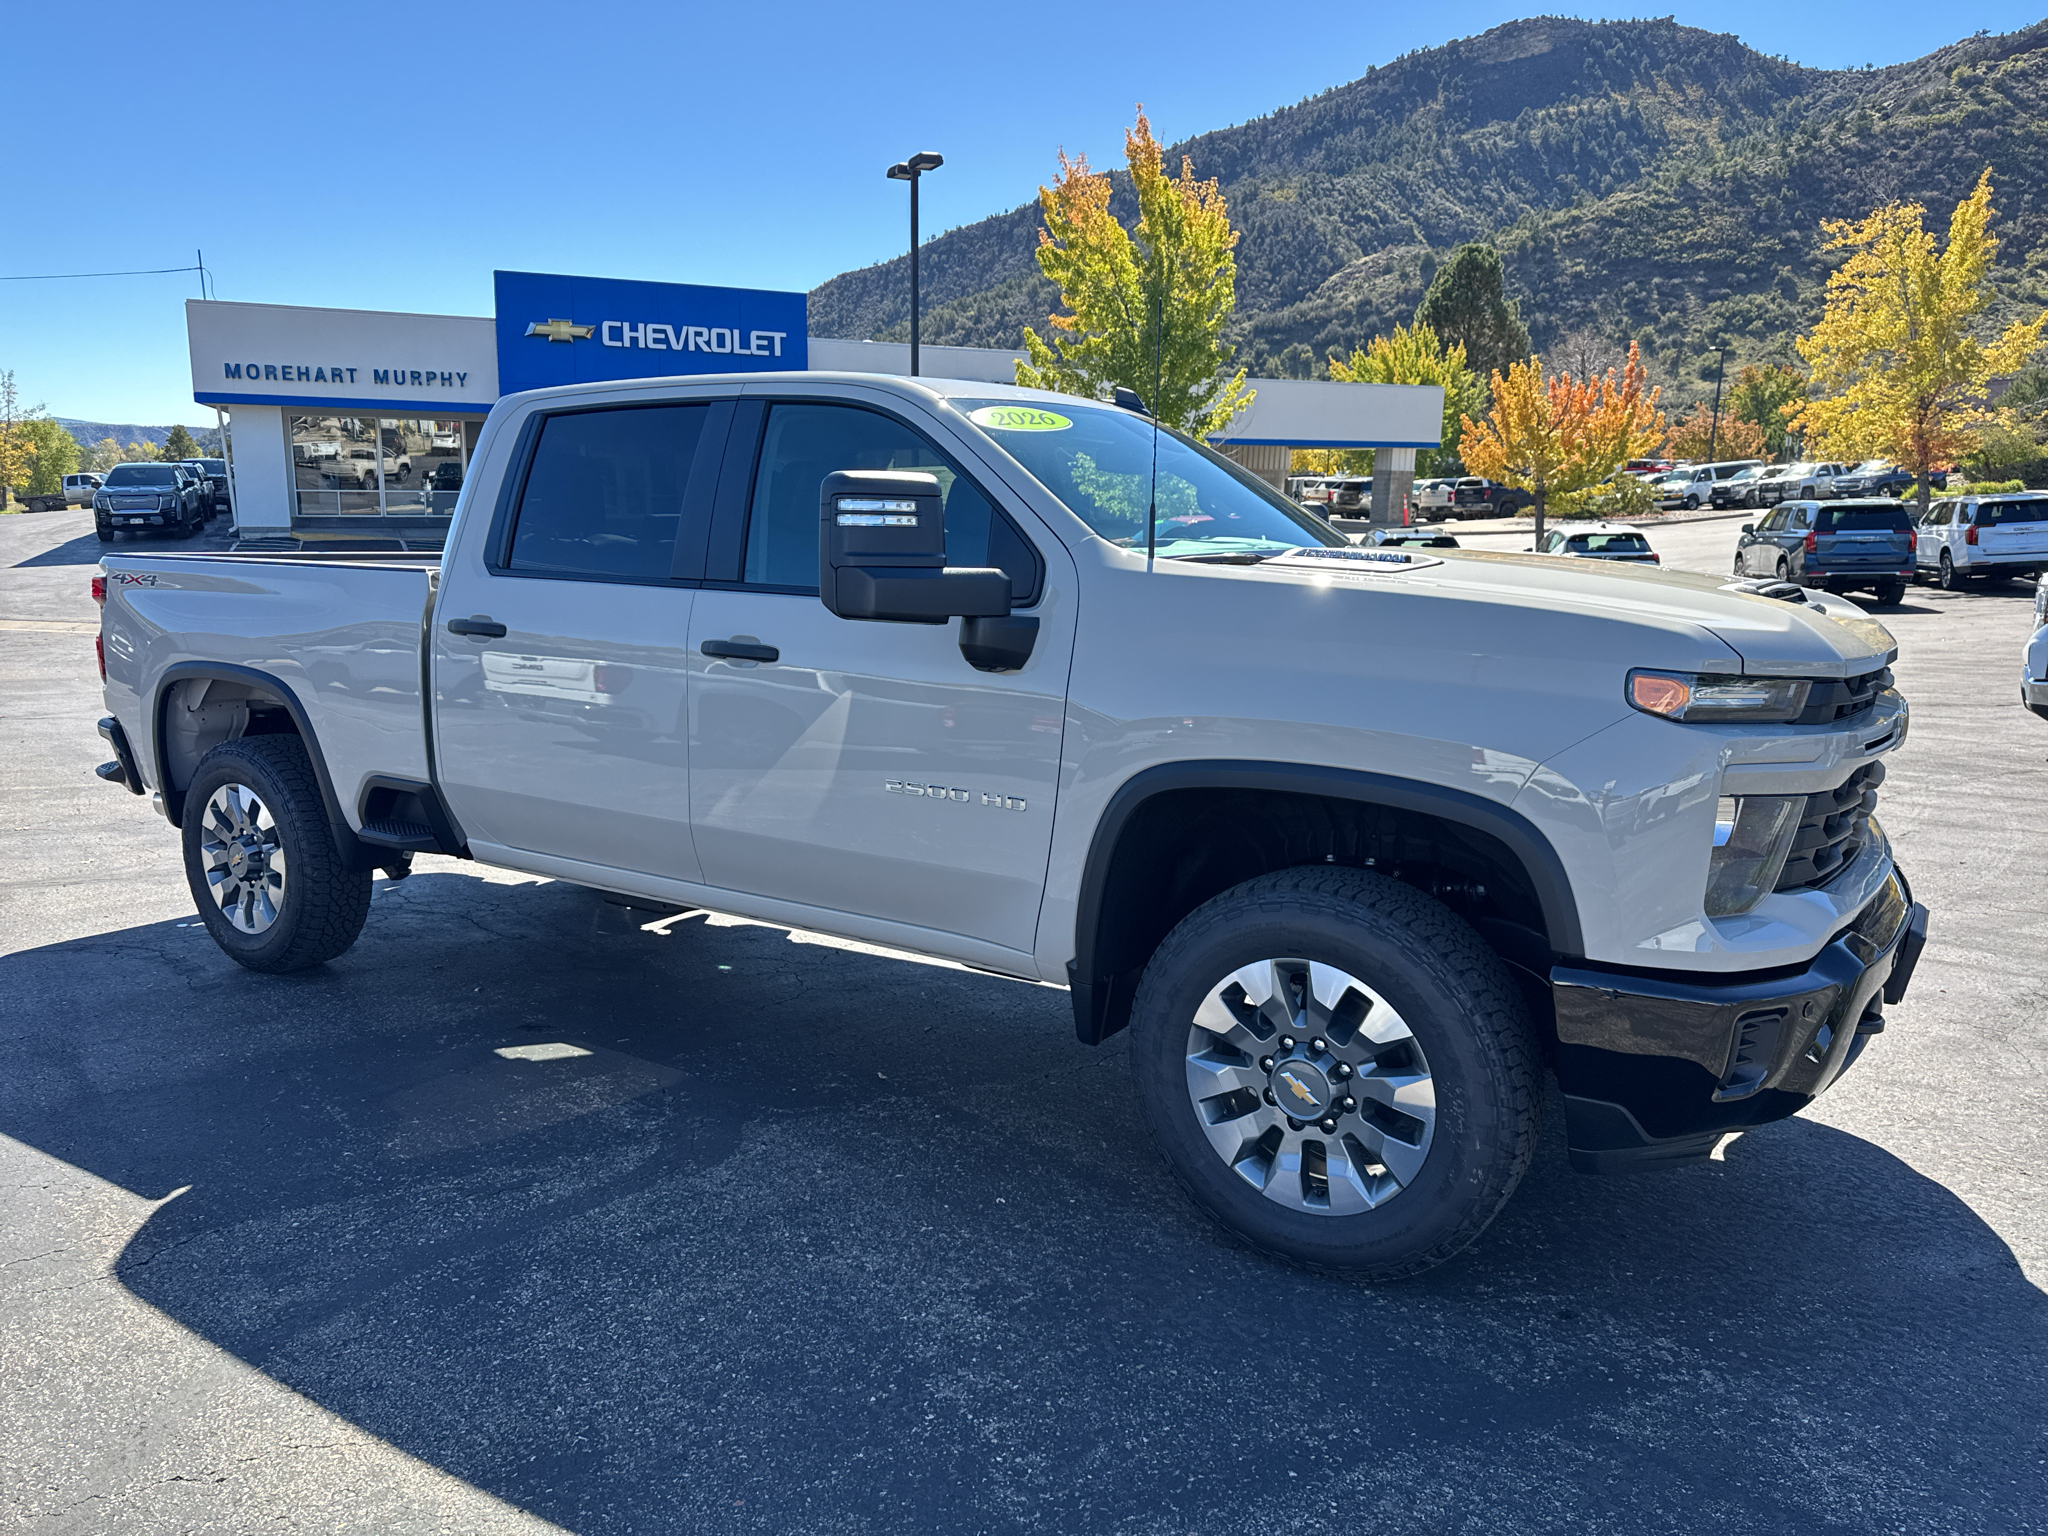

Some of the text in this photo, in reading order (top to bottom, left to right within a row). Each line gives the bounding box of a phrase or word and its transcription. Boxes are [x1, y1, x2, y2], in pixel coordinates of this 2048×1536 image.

[602, 320, 787, 357] CHEVROLET
[224, 362, 468, 388] MOREHART MURPHY
[990, 411, 1056, 426] 2026
[885, 778, 1028, 812] 2500 HD
